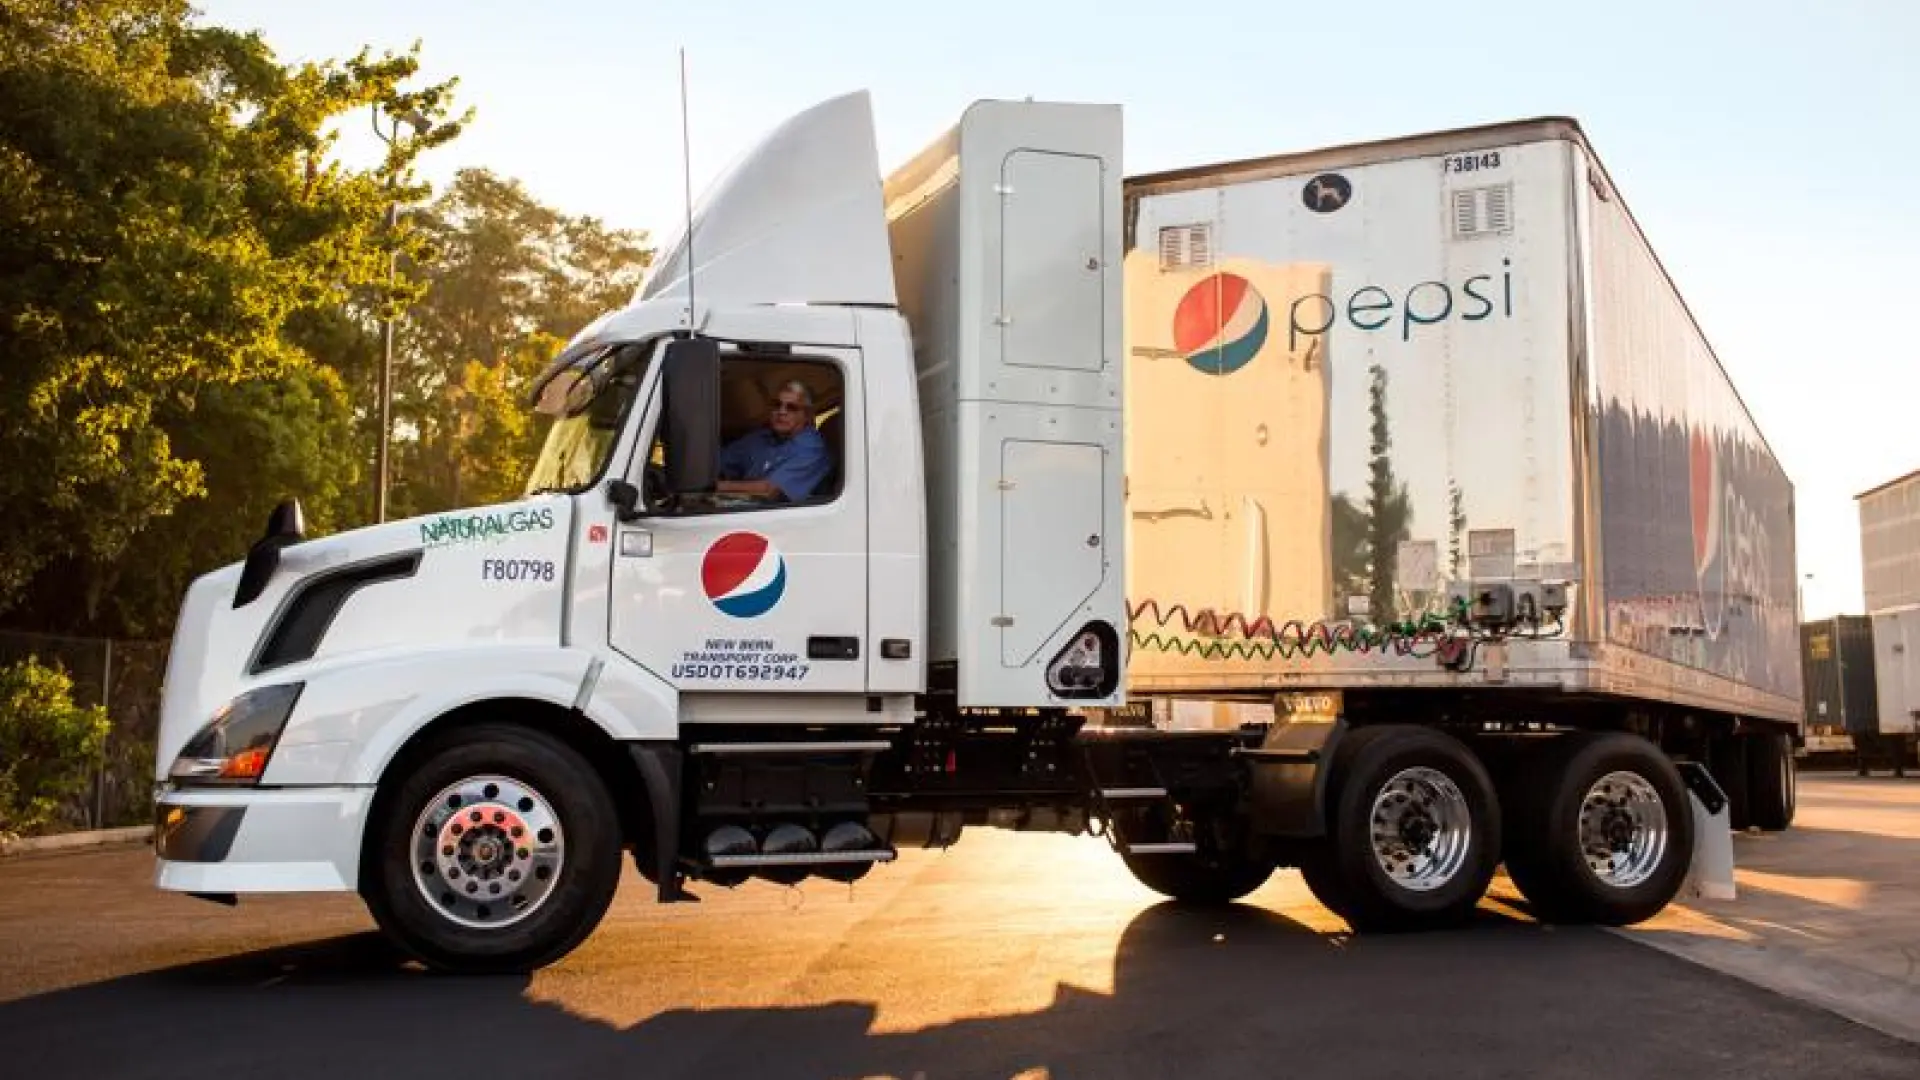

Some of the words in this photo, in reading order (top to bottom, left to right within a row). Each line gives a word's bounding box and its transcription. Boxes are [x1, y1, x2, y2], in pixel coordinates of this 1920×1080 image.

[1444, 152, 1500, 173] F38143
[1289, 257, 1513, 352] pepsi
[482, 559, 555, 582] F80798
[705, 639, 736, 650] NEW
[738, 639, 773, 650] BERN
[684, 652, 760, 663] TRANSPORT
[671, 664, 809, 680] USDOT692947
[1282, 696, 1333, 712] VOLVO
